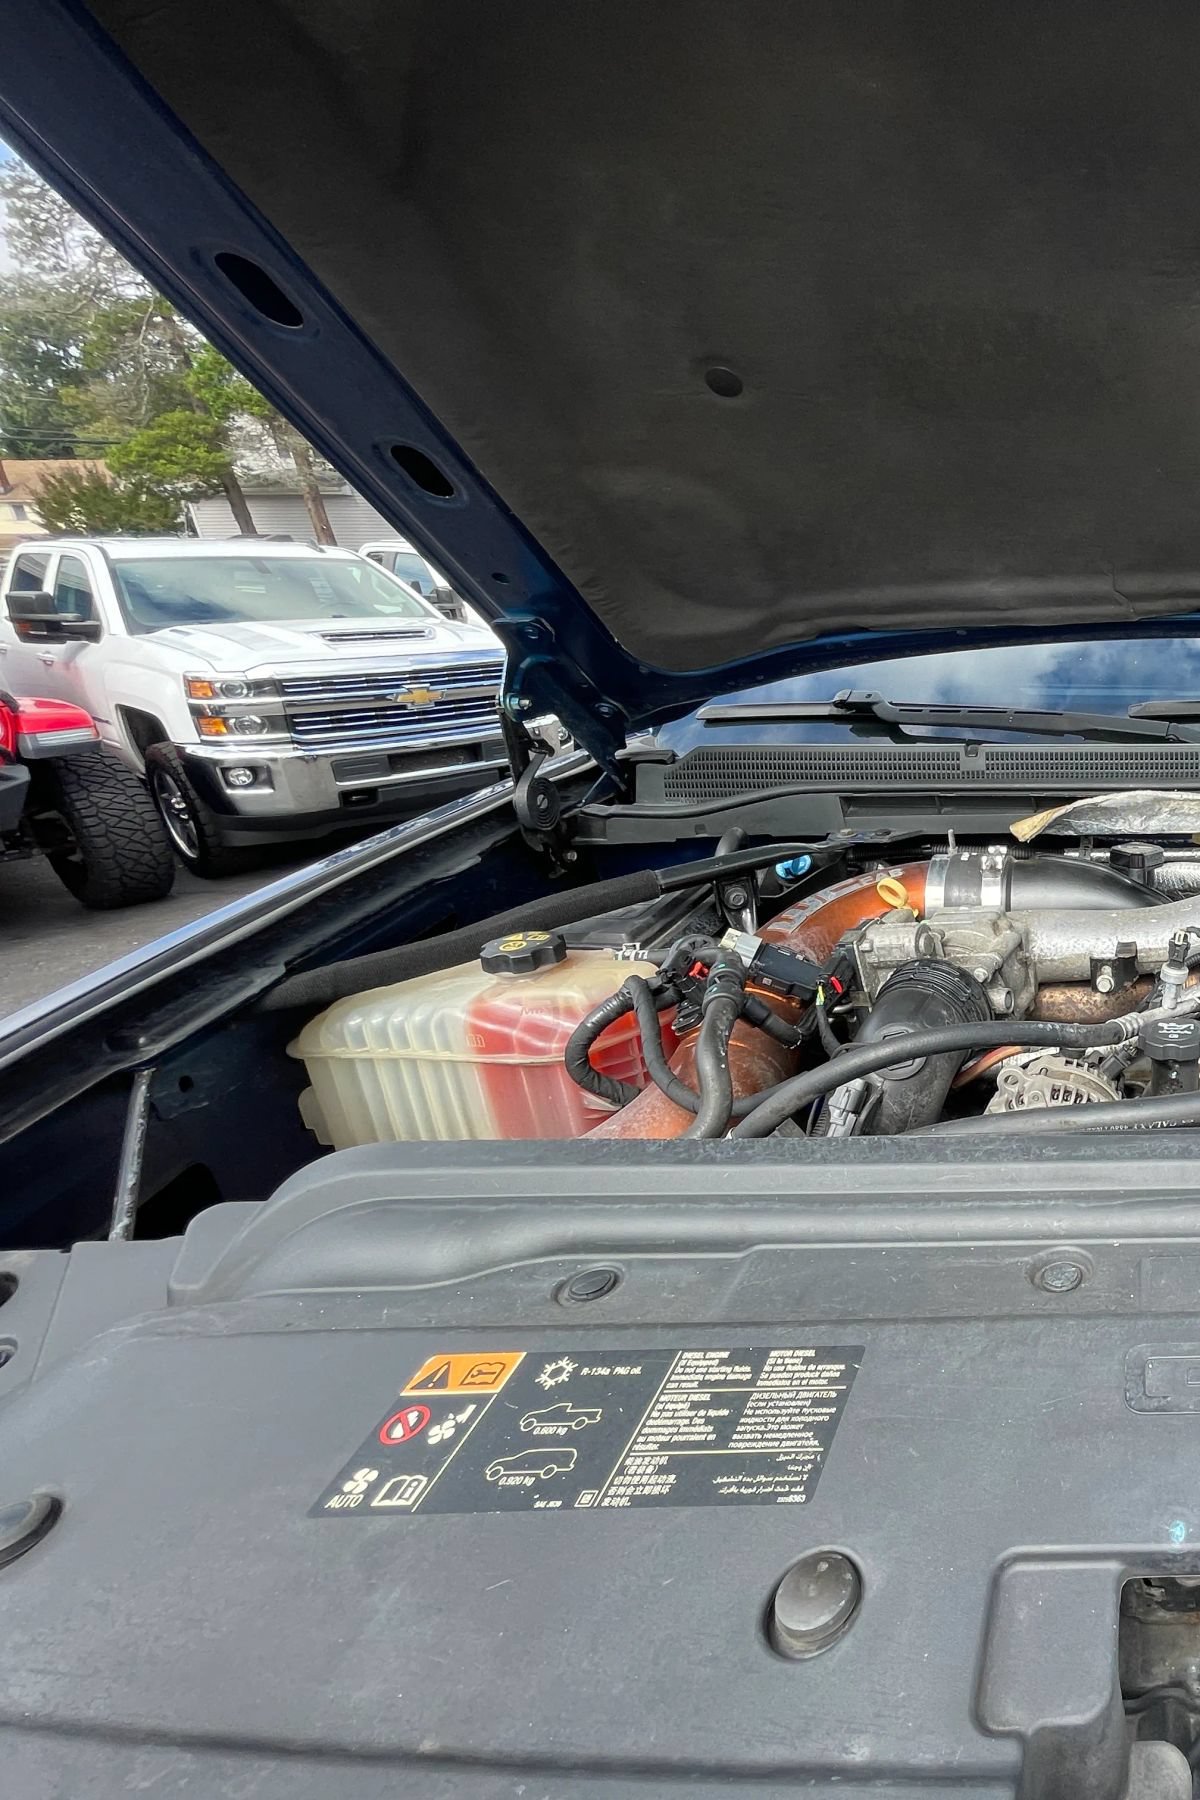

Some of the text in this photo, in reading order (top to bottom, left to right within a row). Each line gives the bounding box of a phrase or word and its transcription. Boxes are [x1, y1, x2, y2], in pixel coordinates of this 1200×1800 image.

[682, 1351, 705, 1359] DIESEL
[769, 1349, 816, 1357] MOTOR DIESEL
[659, 1393, 712, 1402] MOTEUR DIESEL
[750, 1391, 838, 1400] ДИЗЕЛЬНЫЙ ДВИГАТЕЛЬ
[533, 1427, 568, 1436] 0.600 kg
[498, 1476, 536, 1487] 0.920 kg
[324, 1494, 364, 1508] AUTO
